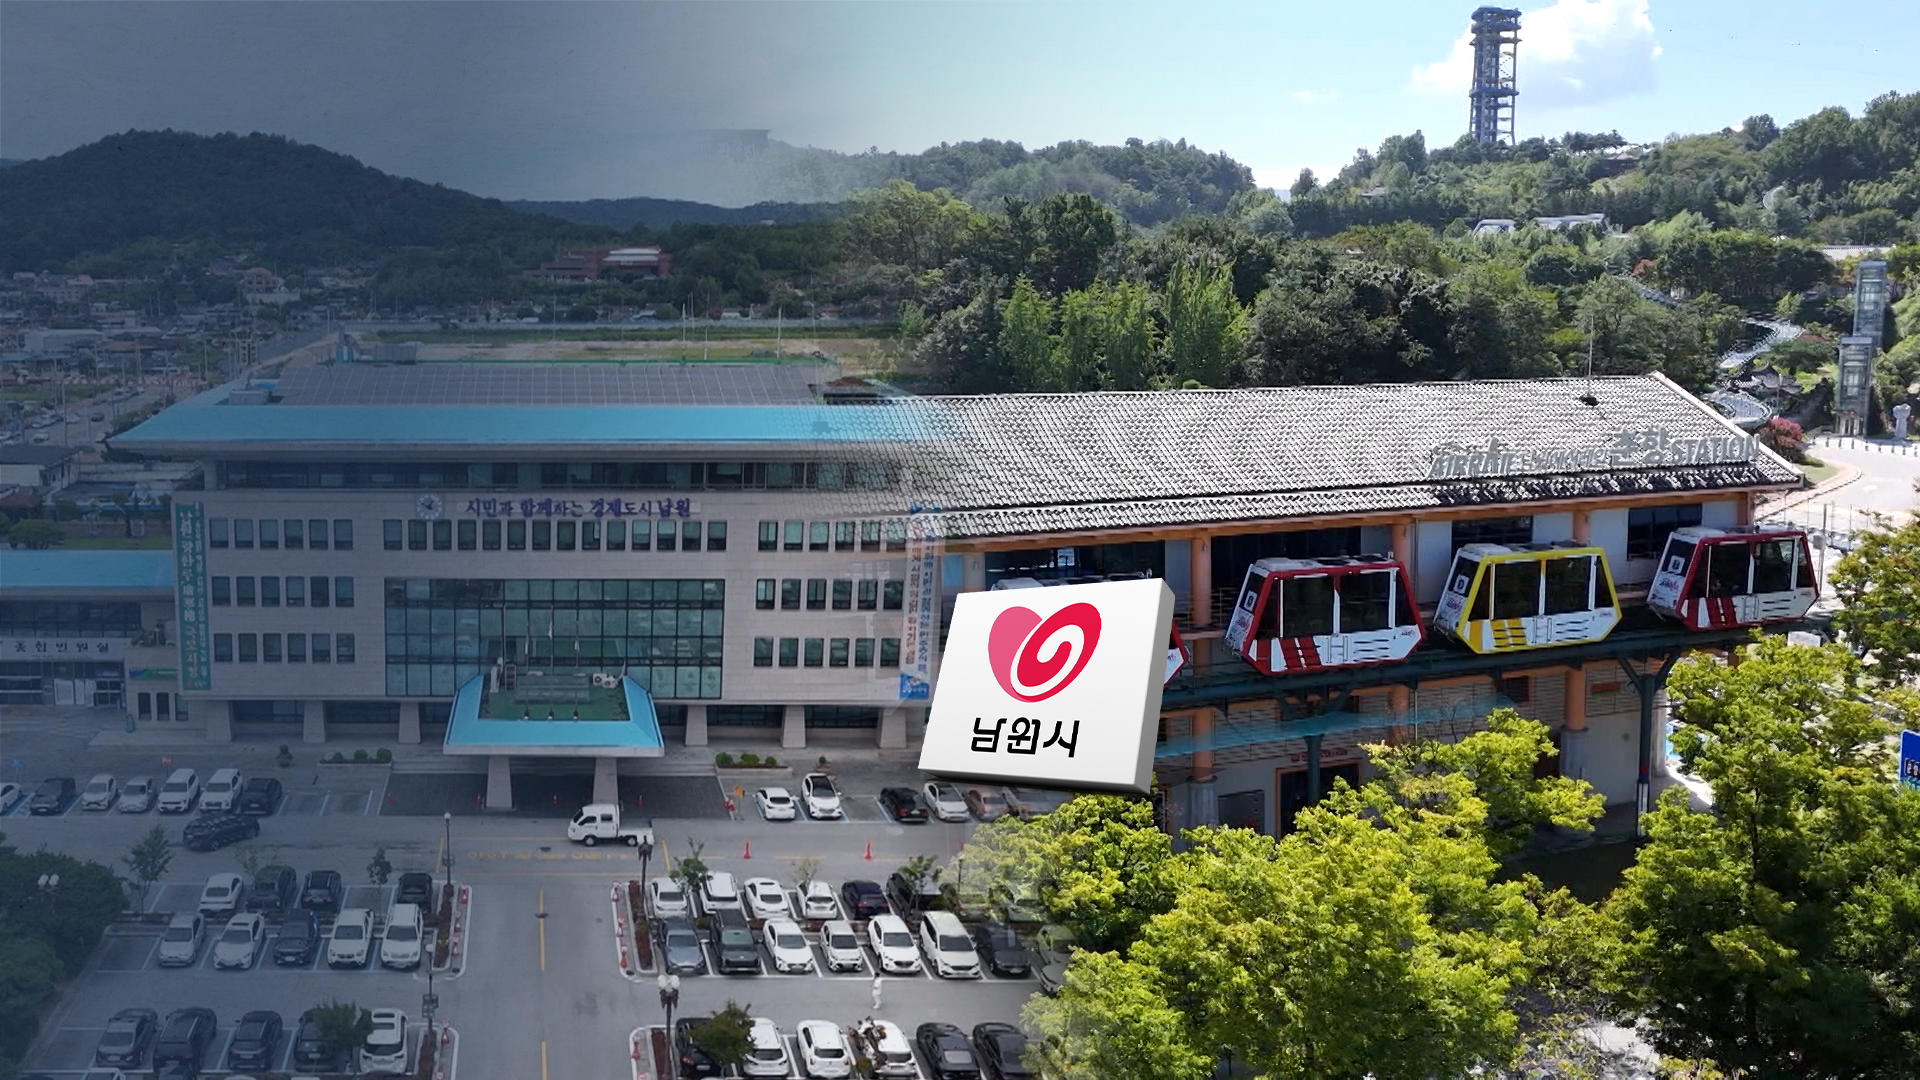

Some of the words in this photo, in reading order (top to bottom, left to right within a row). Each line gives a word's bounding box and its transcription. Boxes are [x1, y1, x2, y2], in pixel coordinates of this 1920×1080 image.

[1671, 434, 1760, 464] STATION
[465, 498, 514, 517] 시민과
[519, 498, 584, 517] 함께하는
[589, 498, 651, 517] 경제도시
[656, 498, 691, 517] 남원
